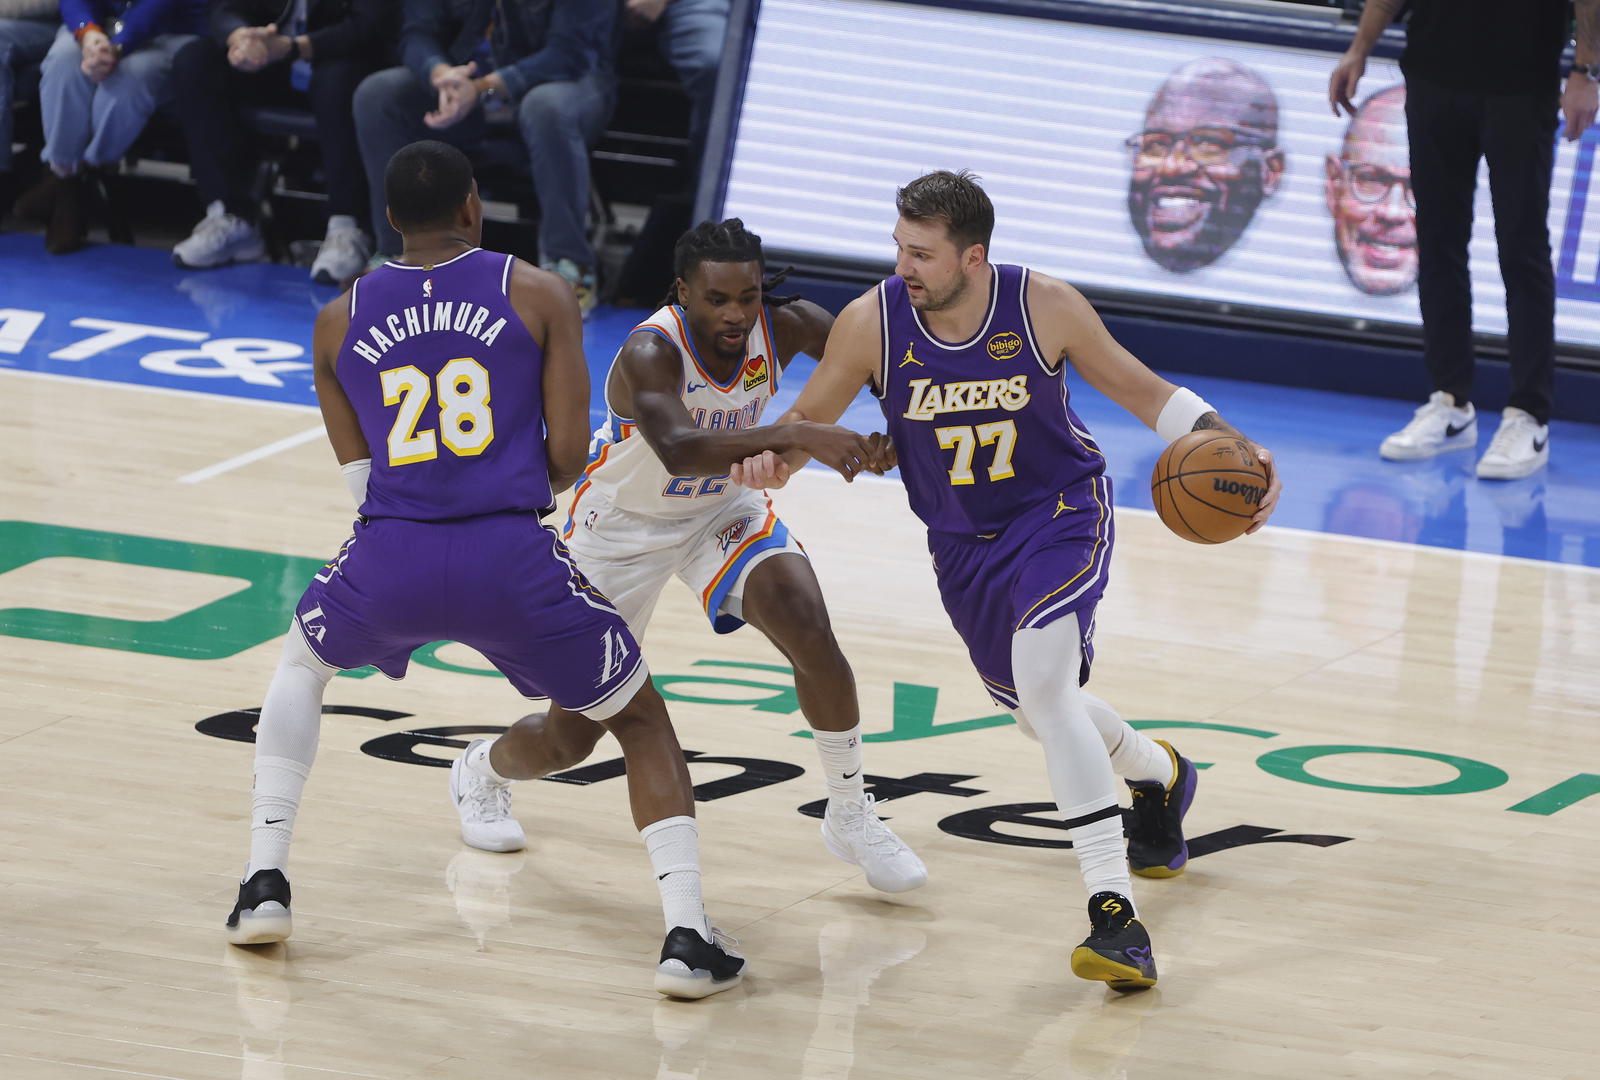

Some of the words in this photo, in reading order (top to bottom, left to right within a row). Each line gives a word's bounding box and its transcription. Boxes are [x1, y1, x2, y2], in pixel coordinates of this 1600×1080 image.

[352, 301, 508, 365] HACHIMURA
[990, 339, 1020, 352] bibigo
[379, 357, 495, 467] 28
[903, 374, 1031, 421] LAKERS
[934, 419, 1018, 486] 77
